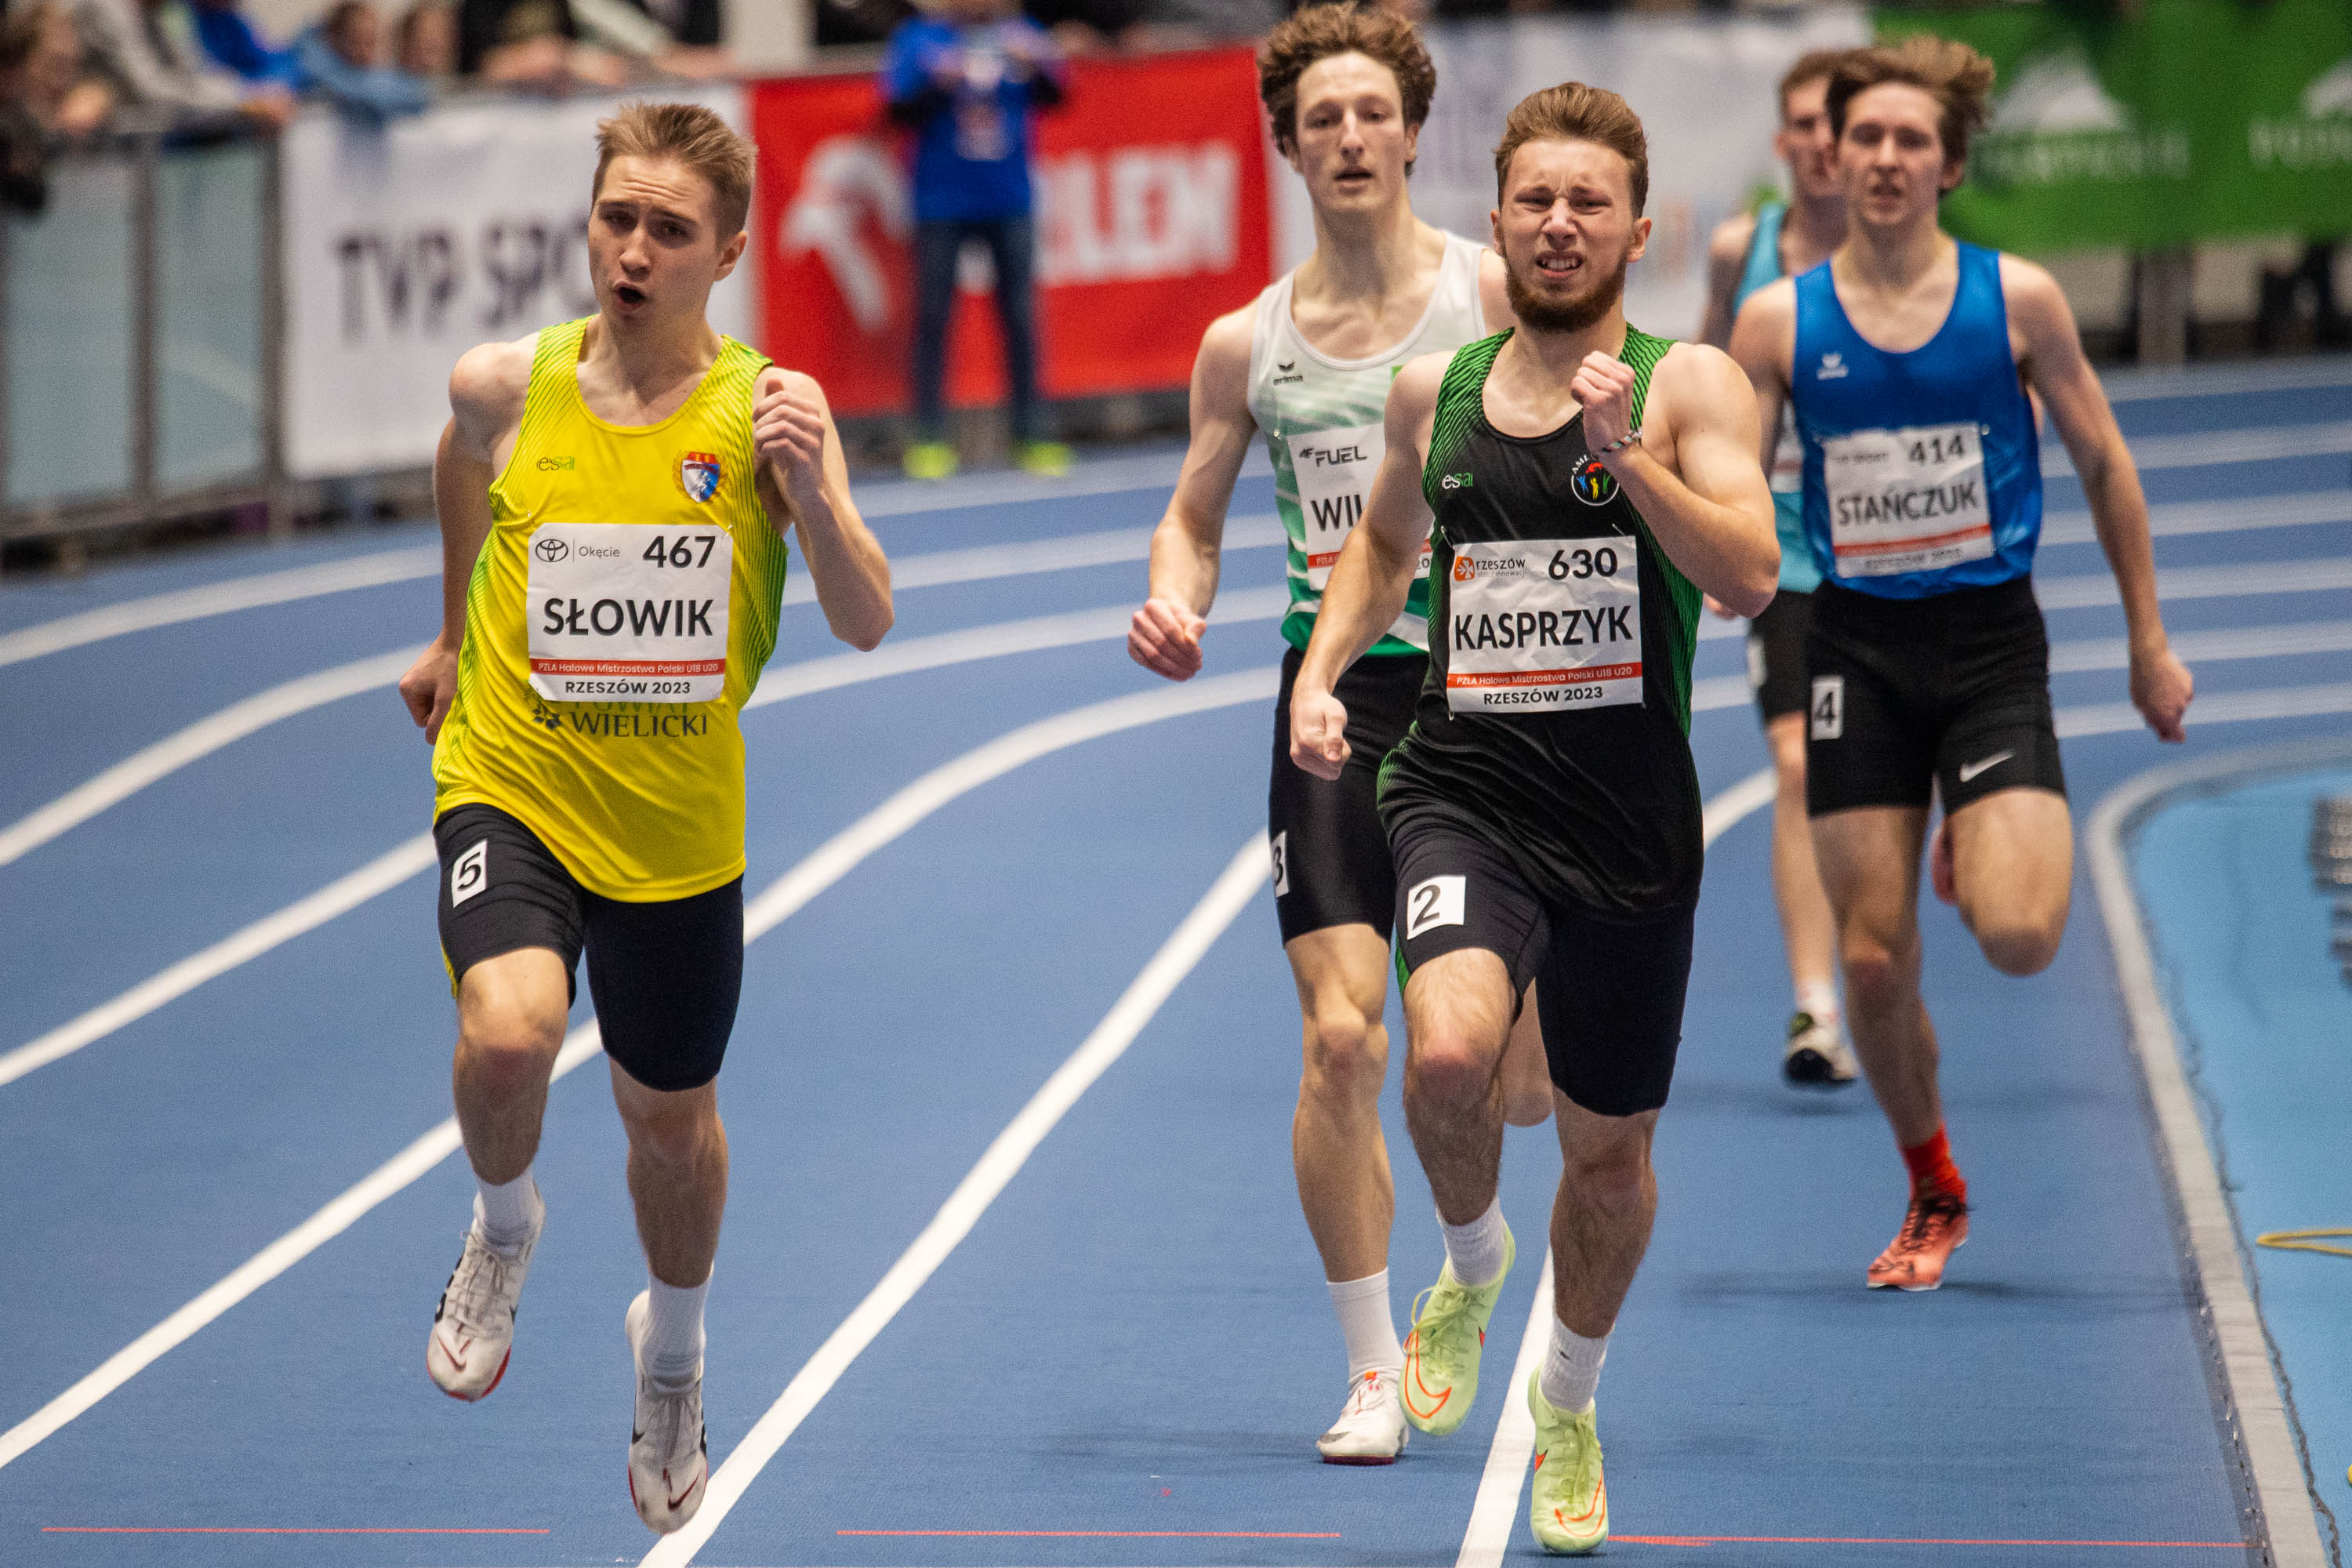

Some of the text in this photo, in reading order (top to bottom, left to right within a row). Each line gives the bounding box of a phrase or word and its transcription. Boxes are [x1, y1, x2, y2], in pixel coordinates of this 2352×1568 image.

[1273, 375, 1303, 386] erima
[1910, 434, 1965, 465] 414
[579, 546, 620, 559] Okęcie
[642, 535, 716, 568] 467
[1475, 558, 1526, 570] rzeszów
[1548, 547, 1617, 580] 630
[543, 597, 714, 637] SŁOWIK
[1455, 605, 1633, 650] KASPRZYK
[539, 662, 718, 673] PZLA Halowe Mistrzostwa Polski U18 U20
[1457, 666, 1632, 685] PZLA Halowe Mistrzostwa Polski U18 U20
[565, 679, 691, 695] RZESZÓW 2023
[1483, 686, 1603, 705] RZESZÓW 2023
[569, 711, 707, 737] WIELICKI
[1817, 690, 1835, 728] 4
[457, 851, 481, 891] 5
[1272, 845, 1284, 887] 3
[1412, 884, 1441, 931] 2
